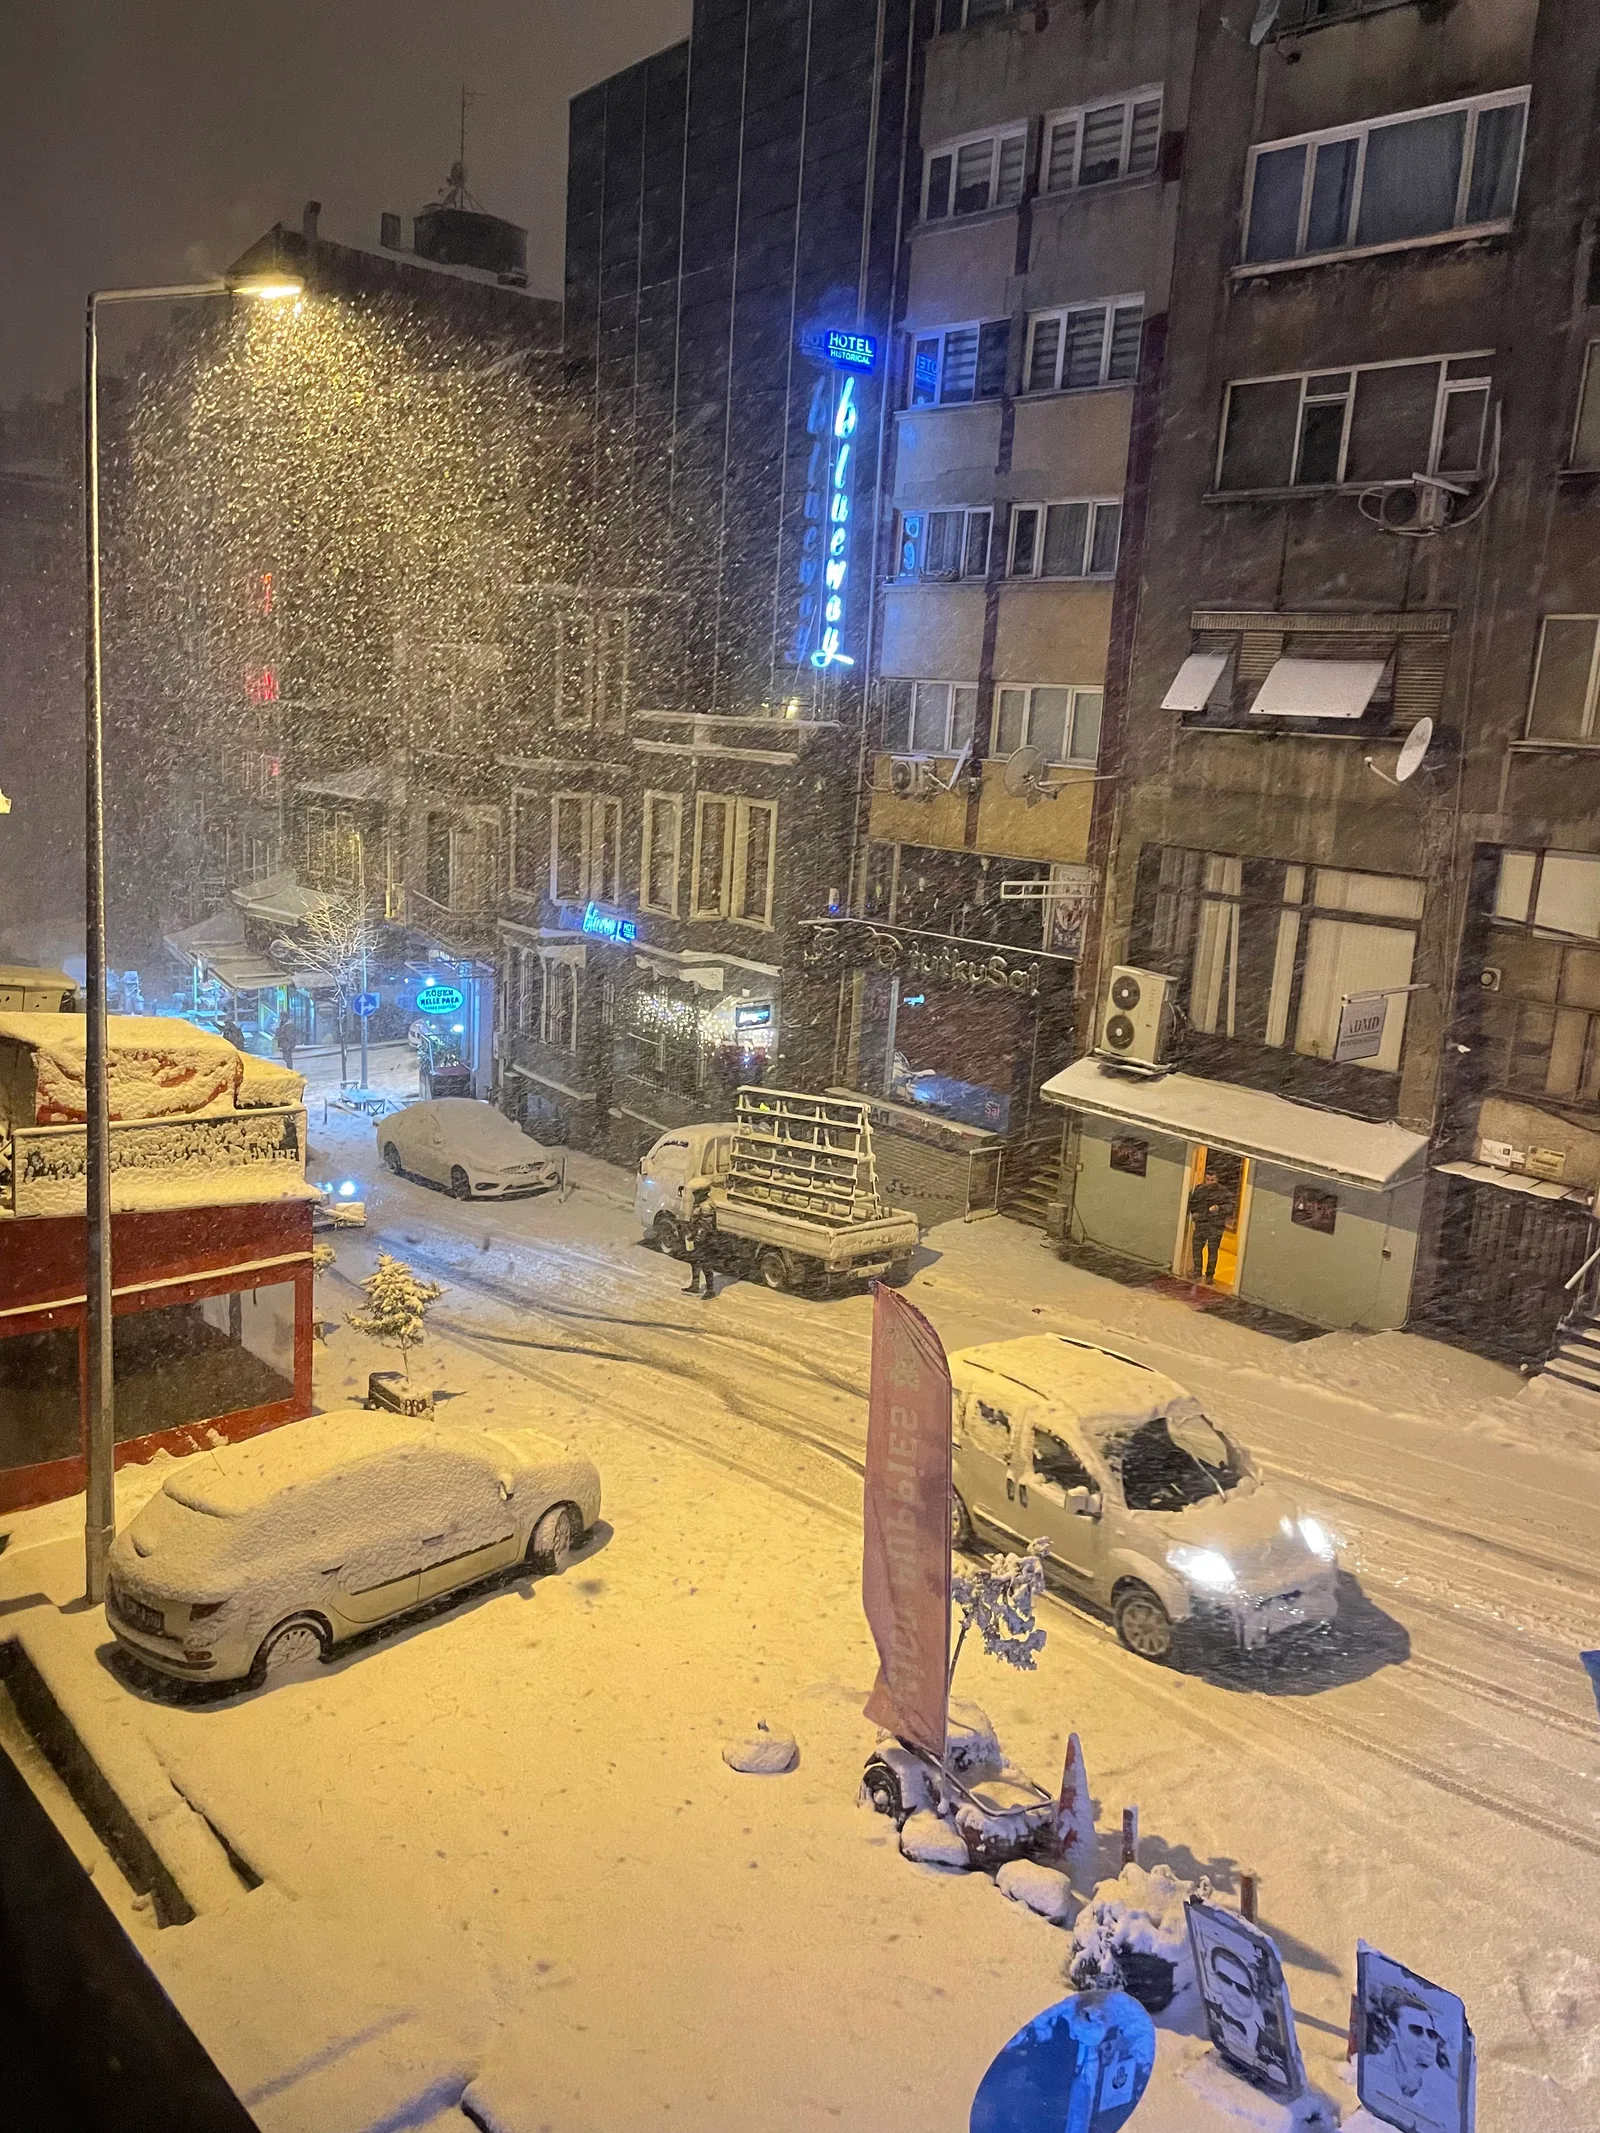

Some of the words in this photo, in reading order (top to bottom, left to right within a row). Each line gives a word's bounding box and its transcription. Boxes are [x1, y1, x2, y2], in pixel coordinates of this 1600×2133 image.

[829, 332, 872, 354] HOTEL
[830, 349, 871, 365] HISTORICAL
[811, 376, 855, 668] blueway
